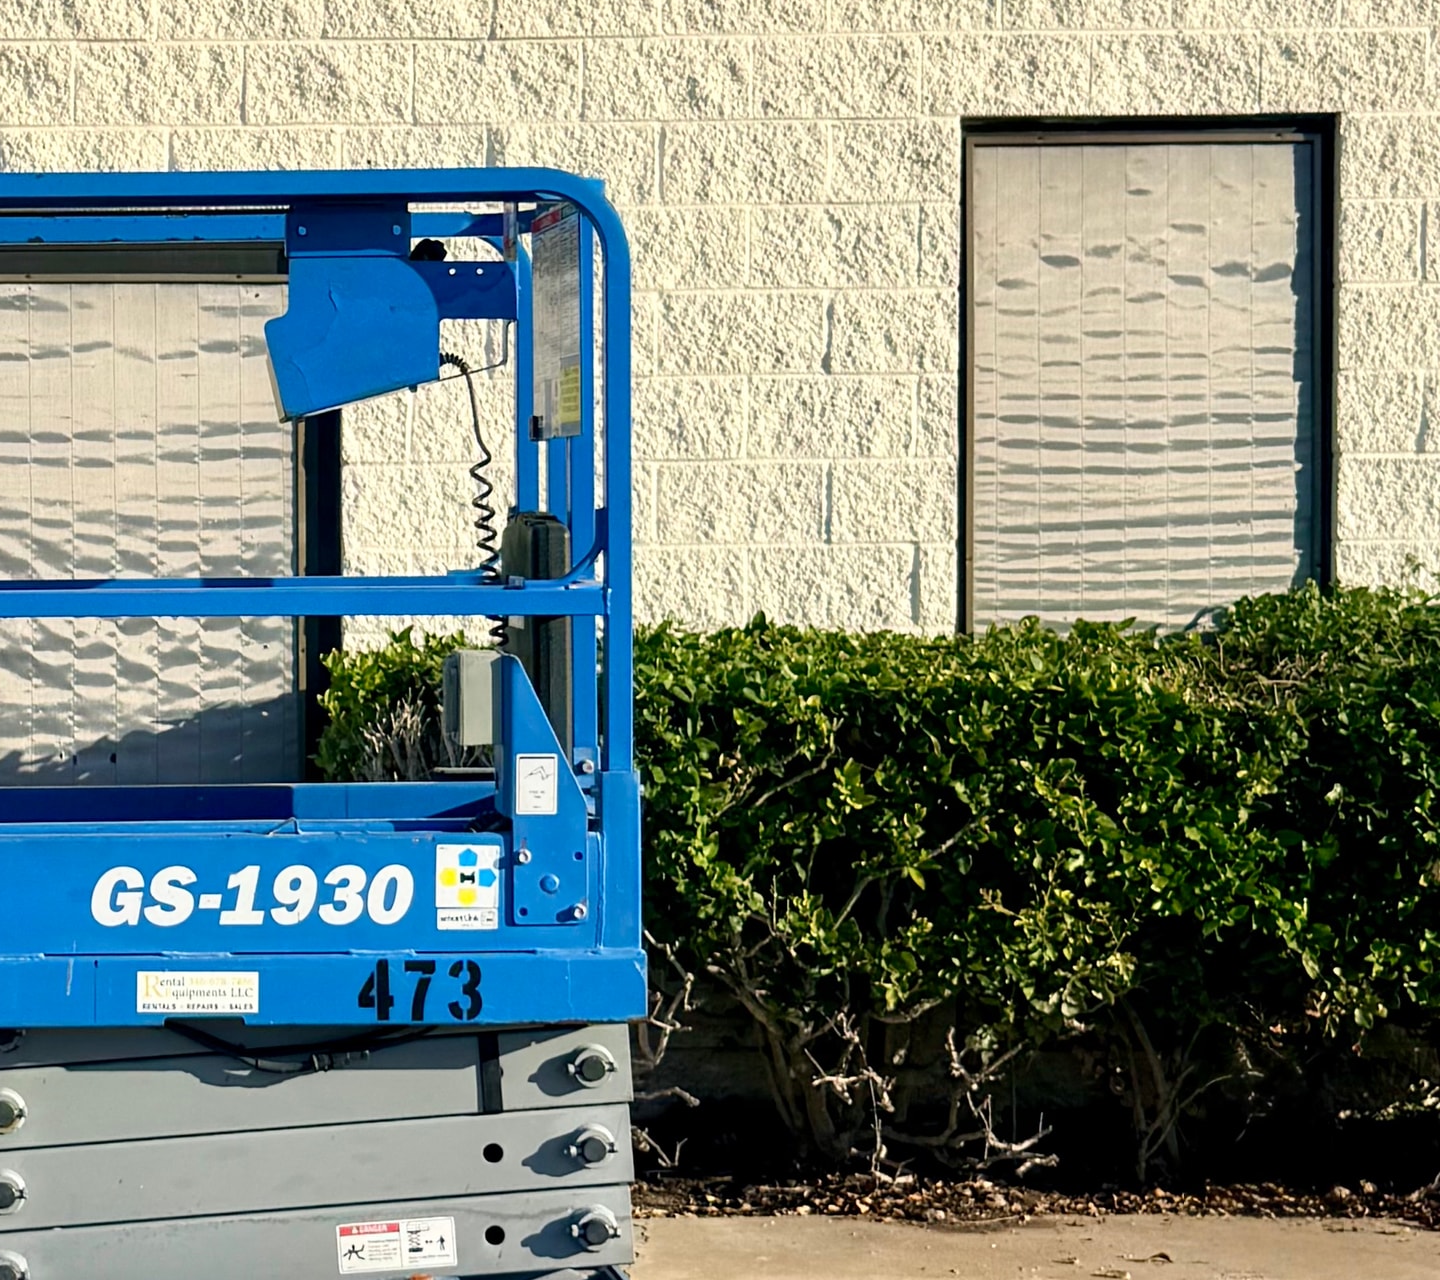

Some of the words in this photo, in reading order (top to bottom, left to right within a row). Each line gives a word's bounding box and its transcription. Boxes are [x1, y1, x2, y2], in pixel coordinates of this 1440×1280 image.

[91, 864, 414, 927] GS-1930
[231, 987, 254, 998] LLC
[357, 958, 482, 1020] 473
